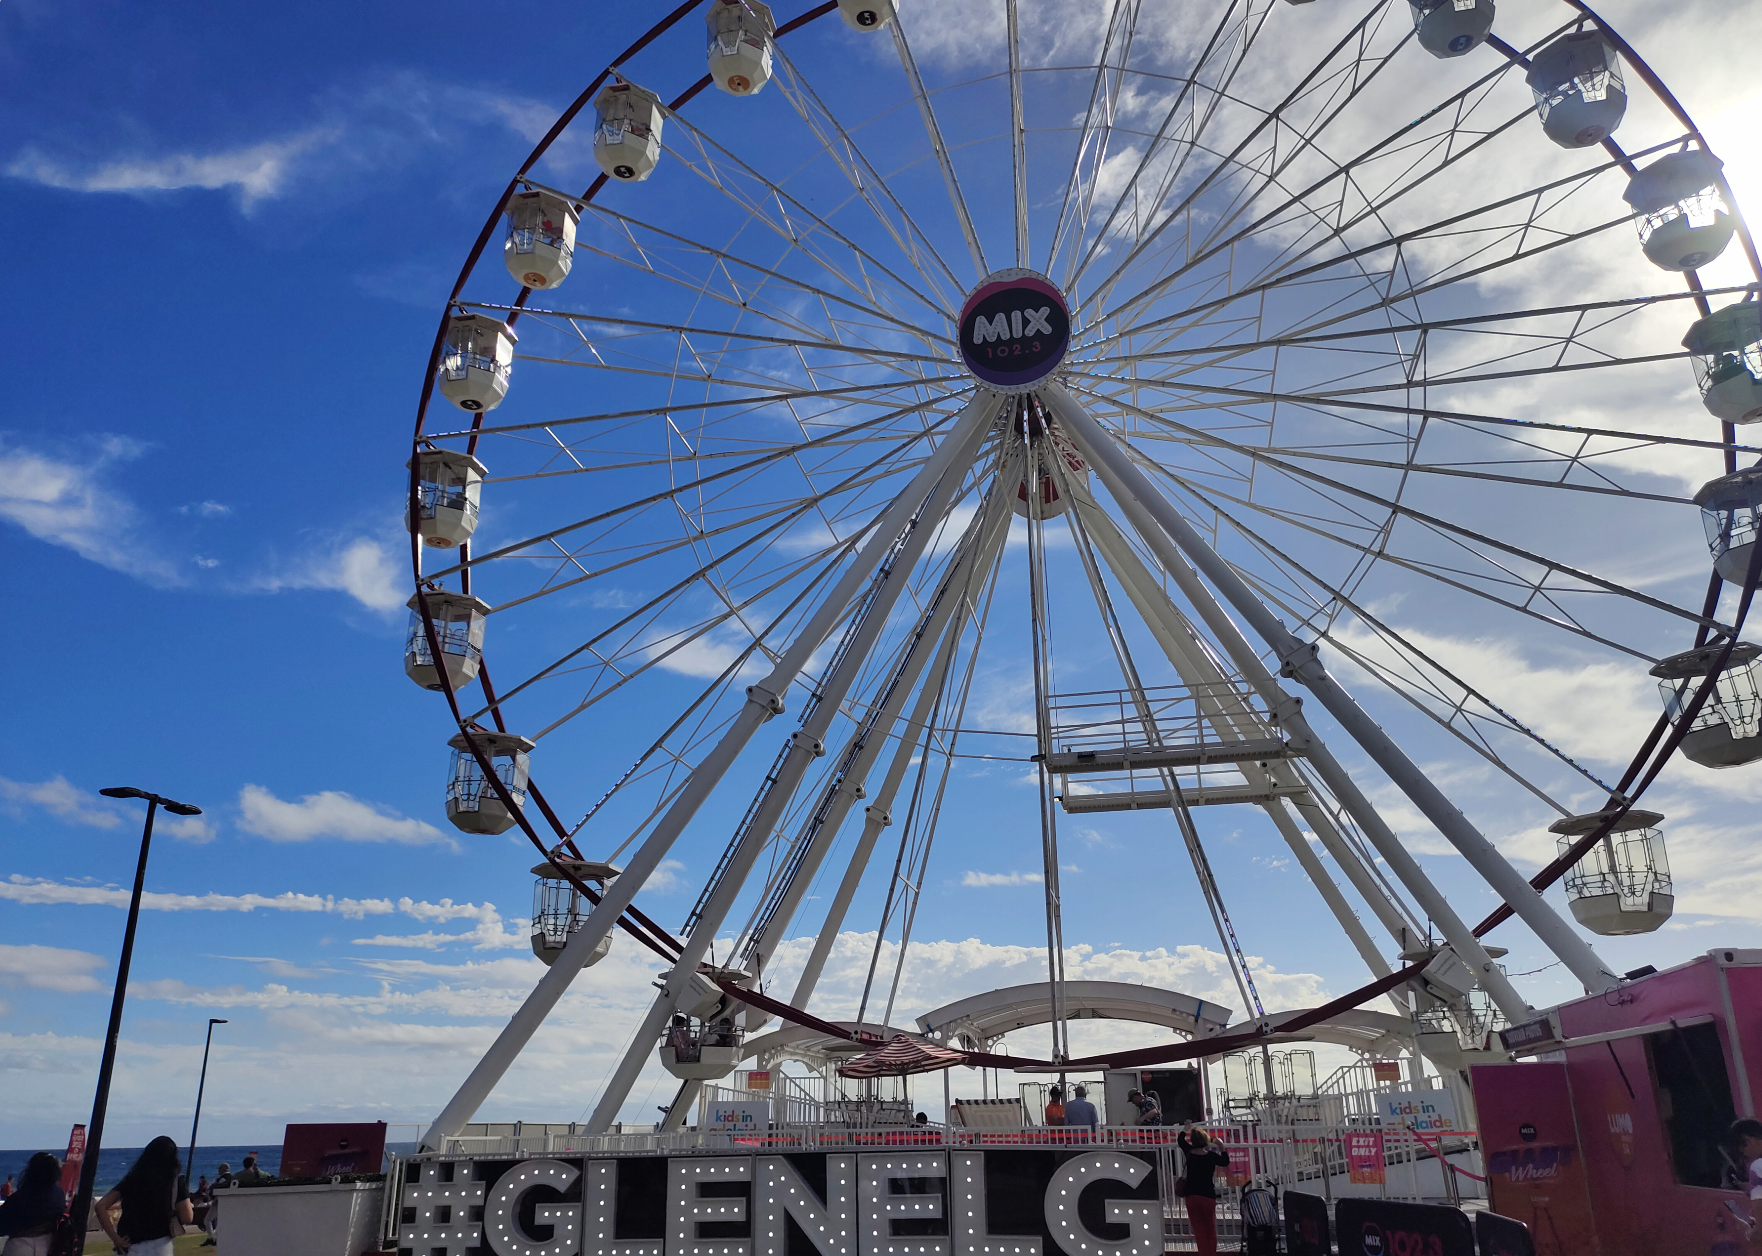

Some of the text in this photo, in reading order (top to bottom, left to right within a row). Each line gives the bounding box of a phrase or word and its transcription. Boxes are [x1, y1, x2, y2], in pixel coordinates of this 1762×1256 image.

[973, 306, 1053, 344] MIX
[987, 341, 1041, 358] 102.3
[715, 1109, 753, 1123] kids in
[1388, 1100, 1436, 1116] kids in
[1351, 1137, 1375, 1146] EXIT
[1351, 1147, 1377, 1156] ONLY
[1510, 1163, 1558, 1182] Wheel
[400, 1153, 1164, 1256] #GLENELG
[1364, 1233, 1381, 1247] MIX
[1384, 1229, 1444, 1256] 1023
